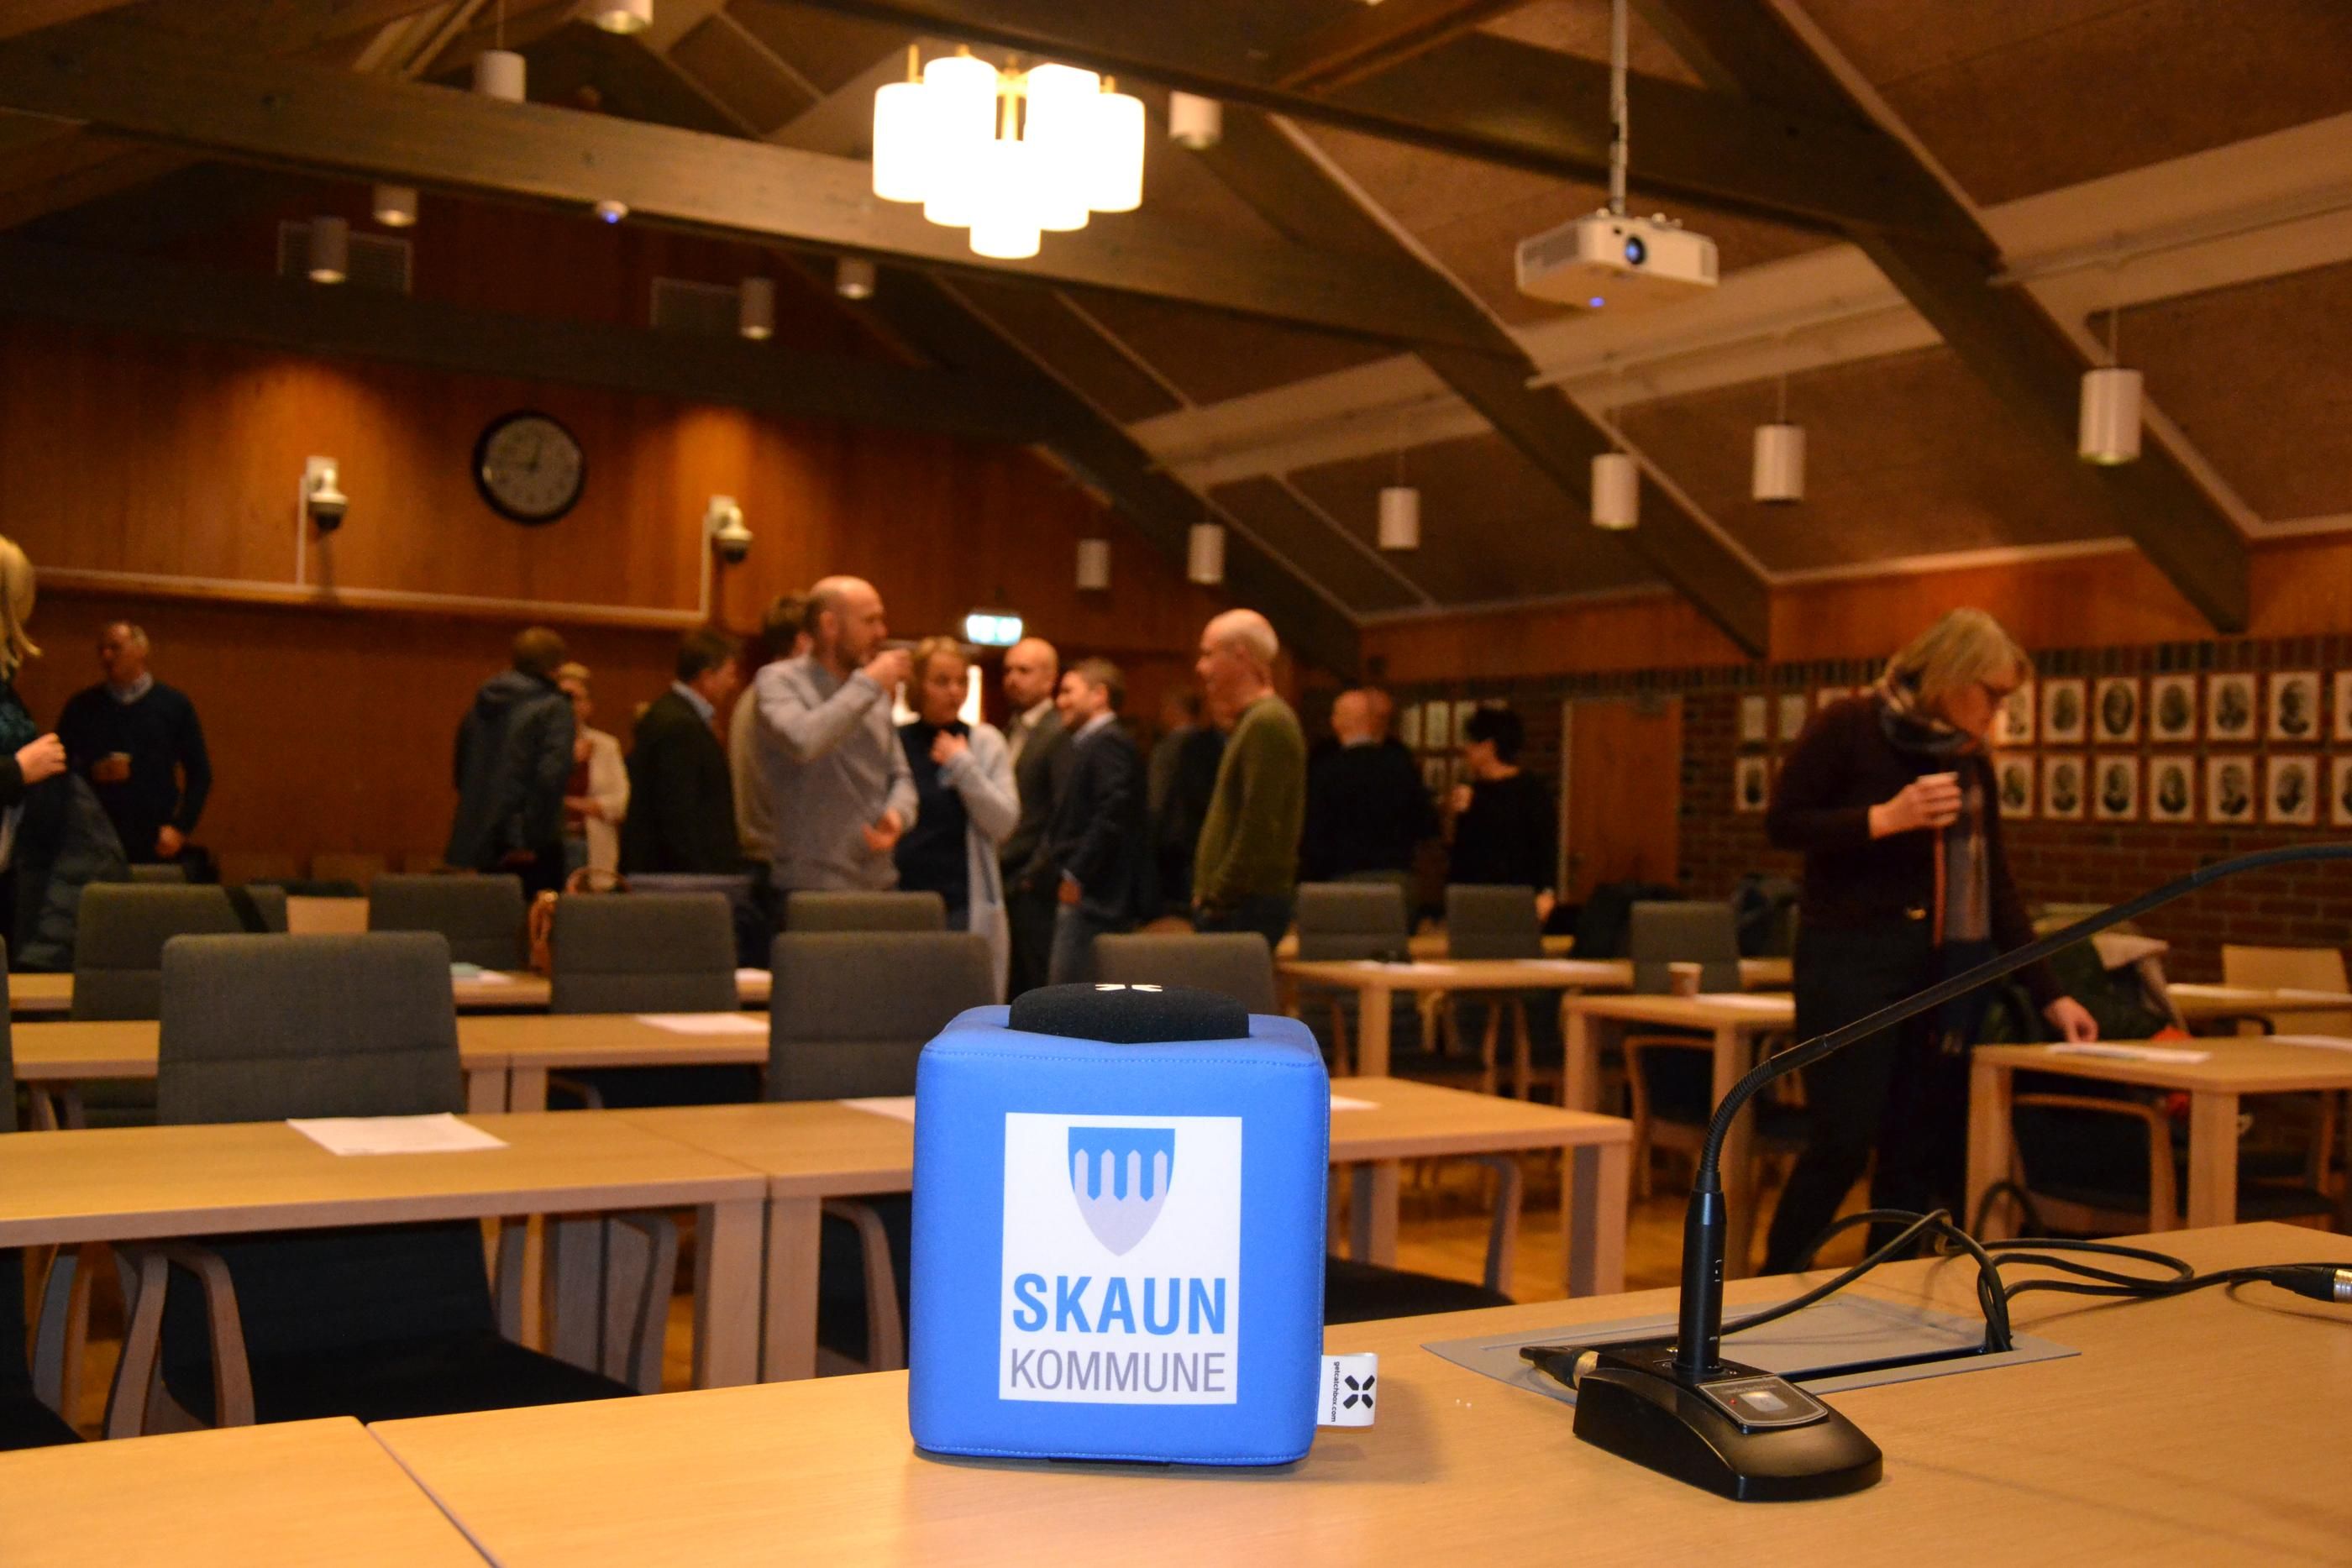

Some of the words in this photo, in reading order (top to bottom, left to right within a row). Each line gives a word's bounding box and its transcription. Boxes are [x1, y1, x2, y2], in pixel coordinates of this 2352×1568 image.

[1012, 1272, 1226, 1335] SKAUN
[1011, 1349, 1226, 1393] KOMMUNE
[1331, 1361, 1341, 1423] getcatchbox.com
